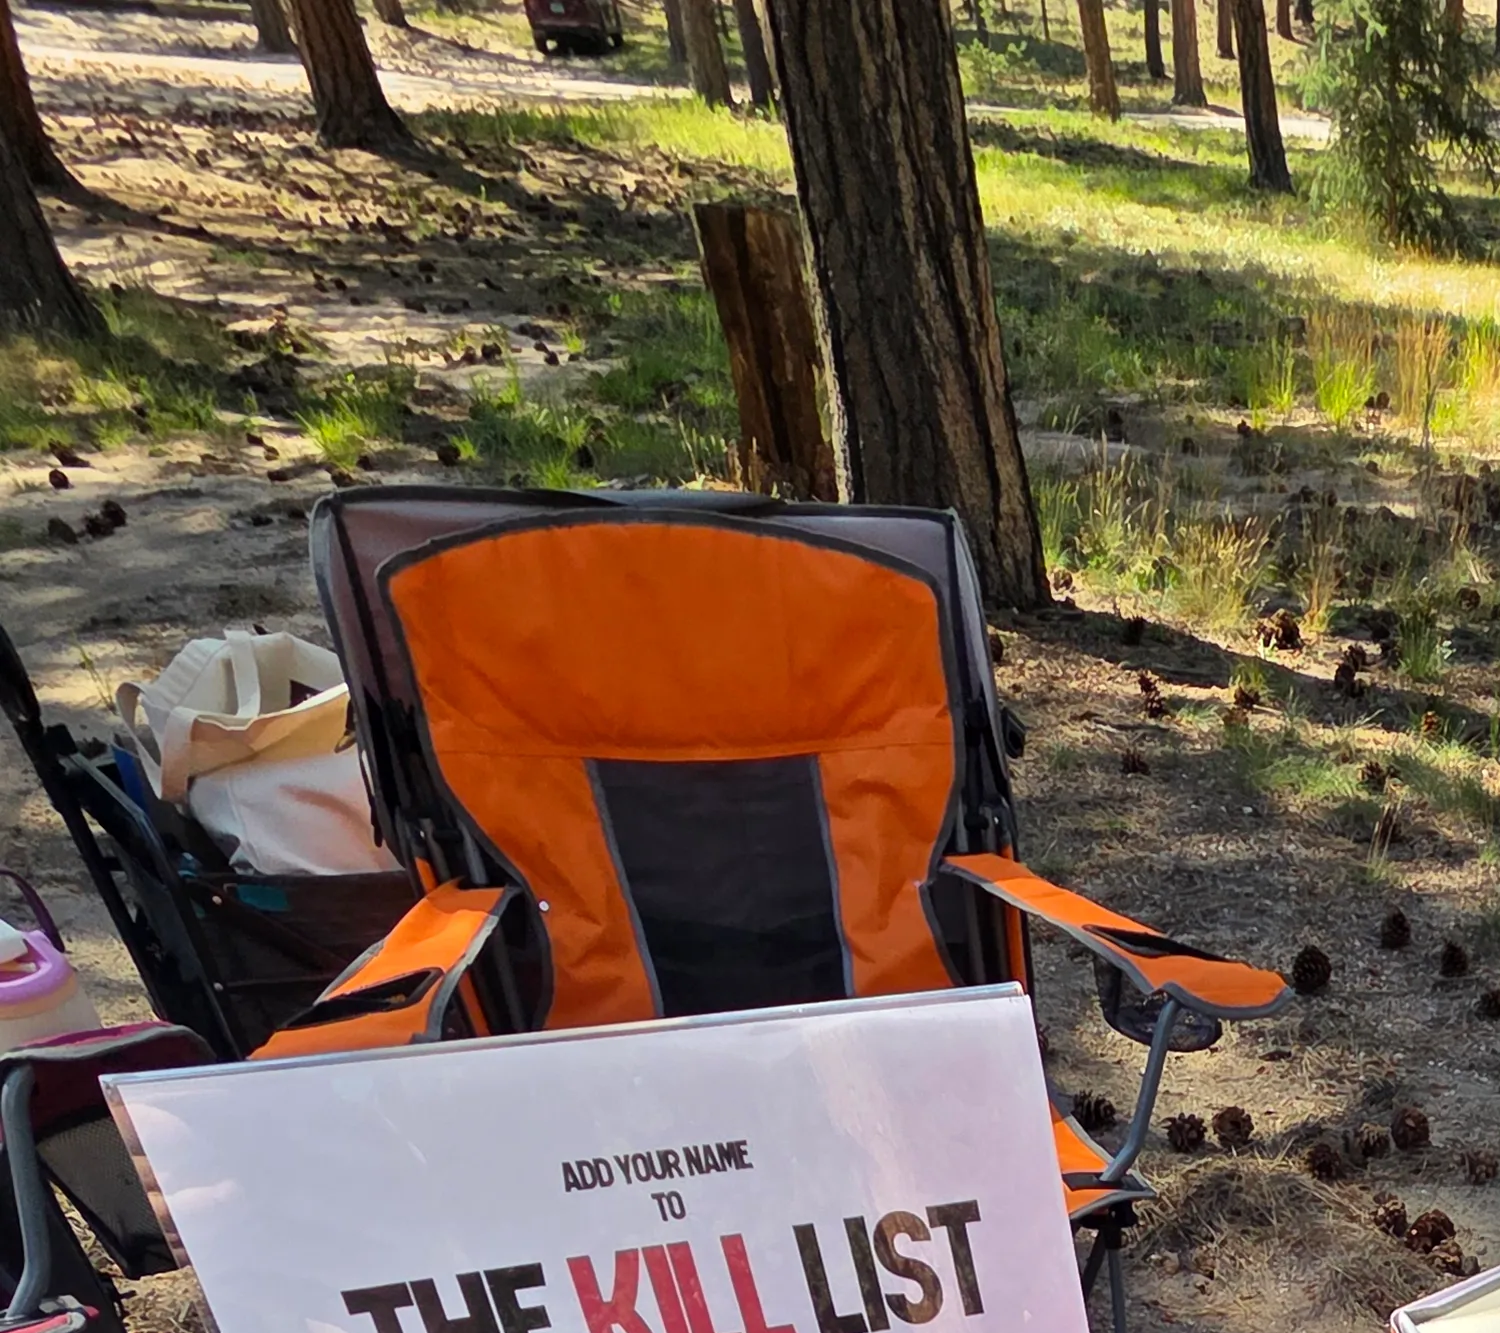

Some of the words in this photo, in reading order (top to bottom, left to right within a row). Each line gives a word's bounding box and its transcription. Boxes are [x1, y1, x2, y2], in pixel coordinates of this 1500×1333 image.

[561, 1158, 616, 1193] ADD
[616, 1149, 684, 1188] YOUR
[684, 1140, 753, 1177] NAME
[650, 1190, 686, 1222] TO
